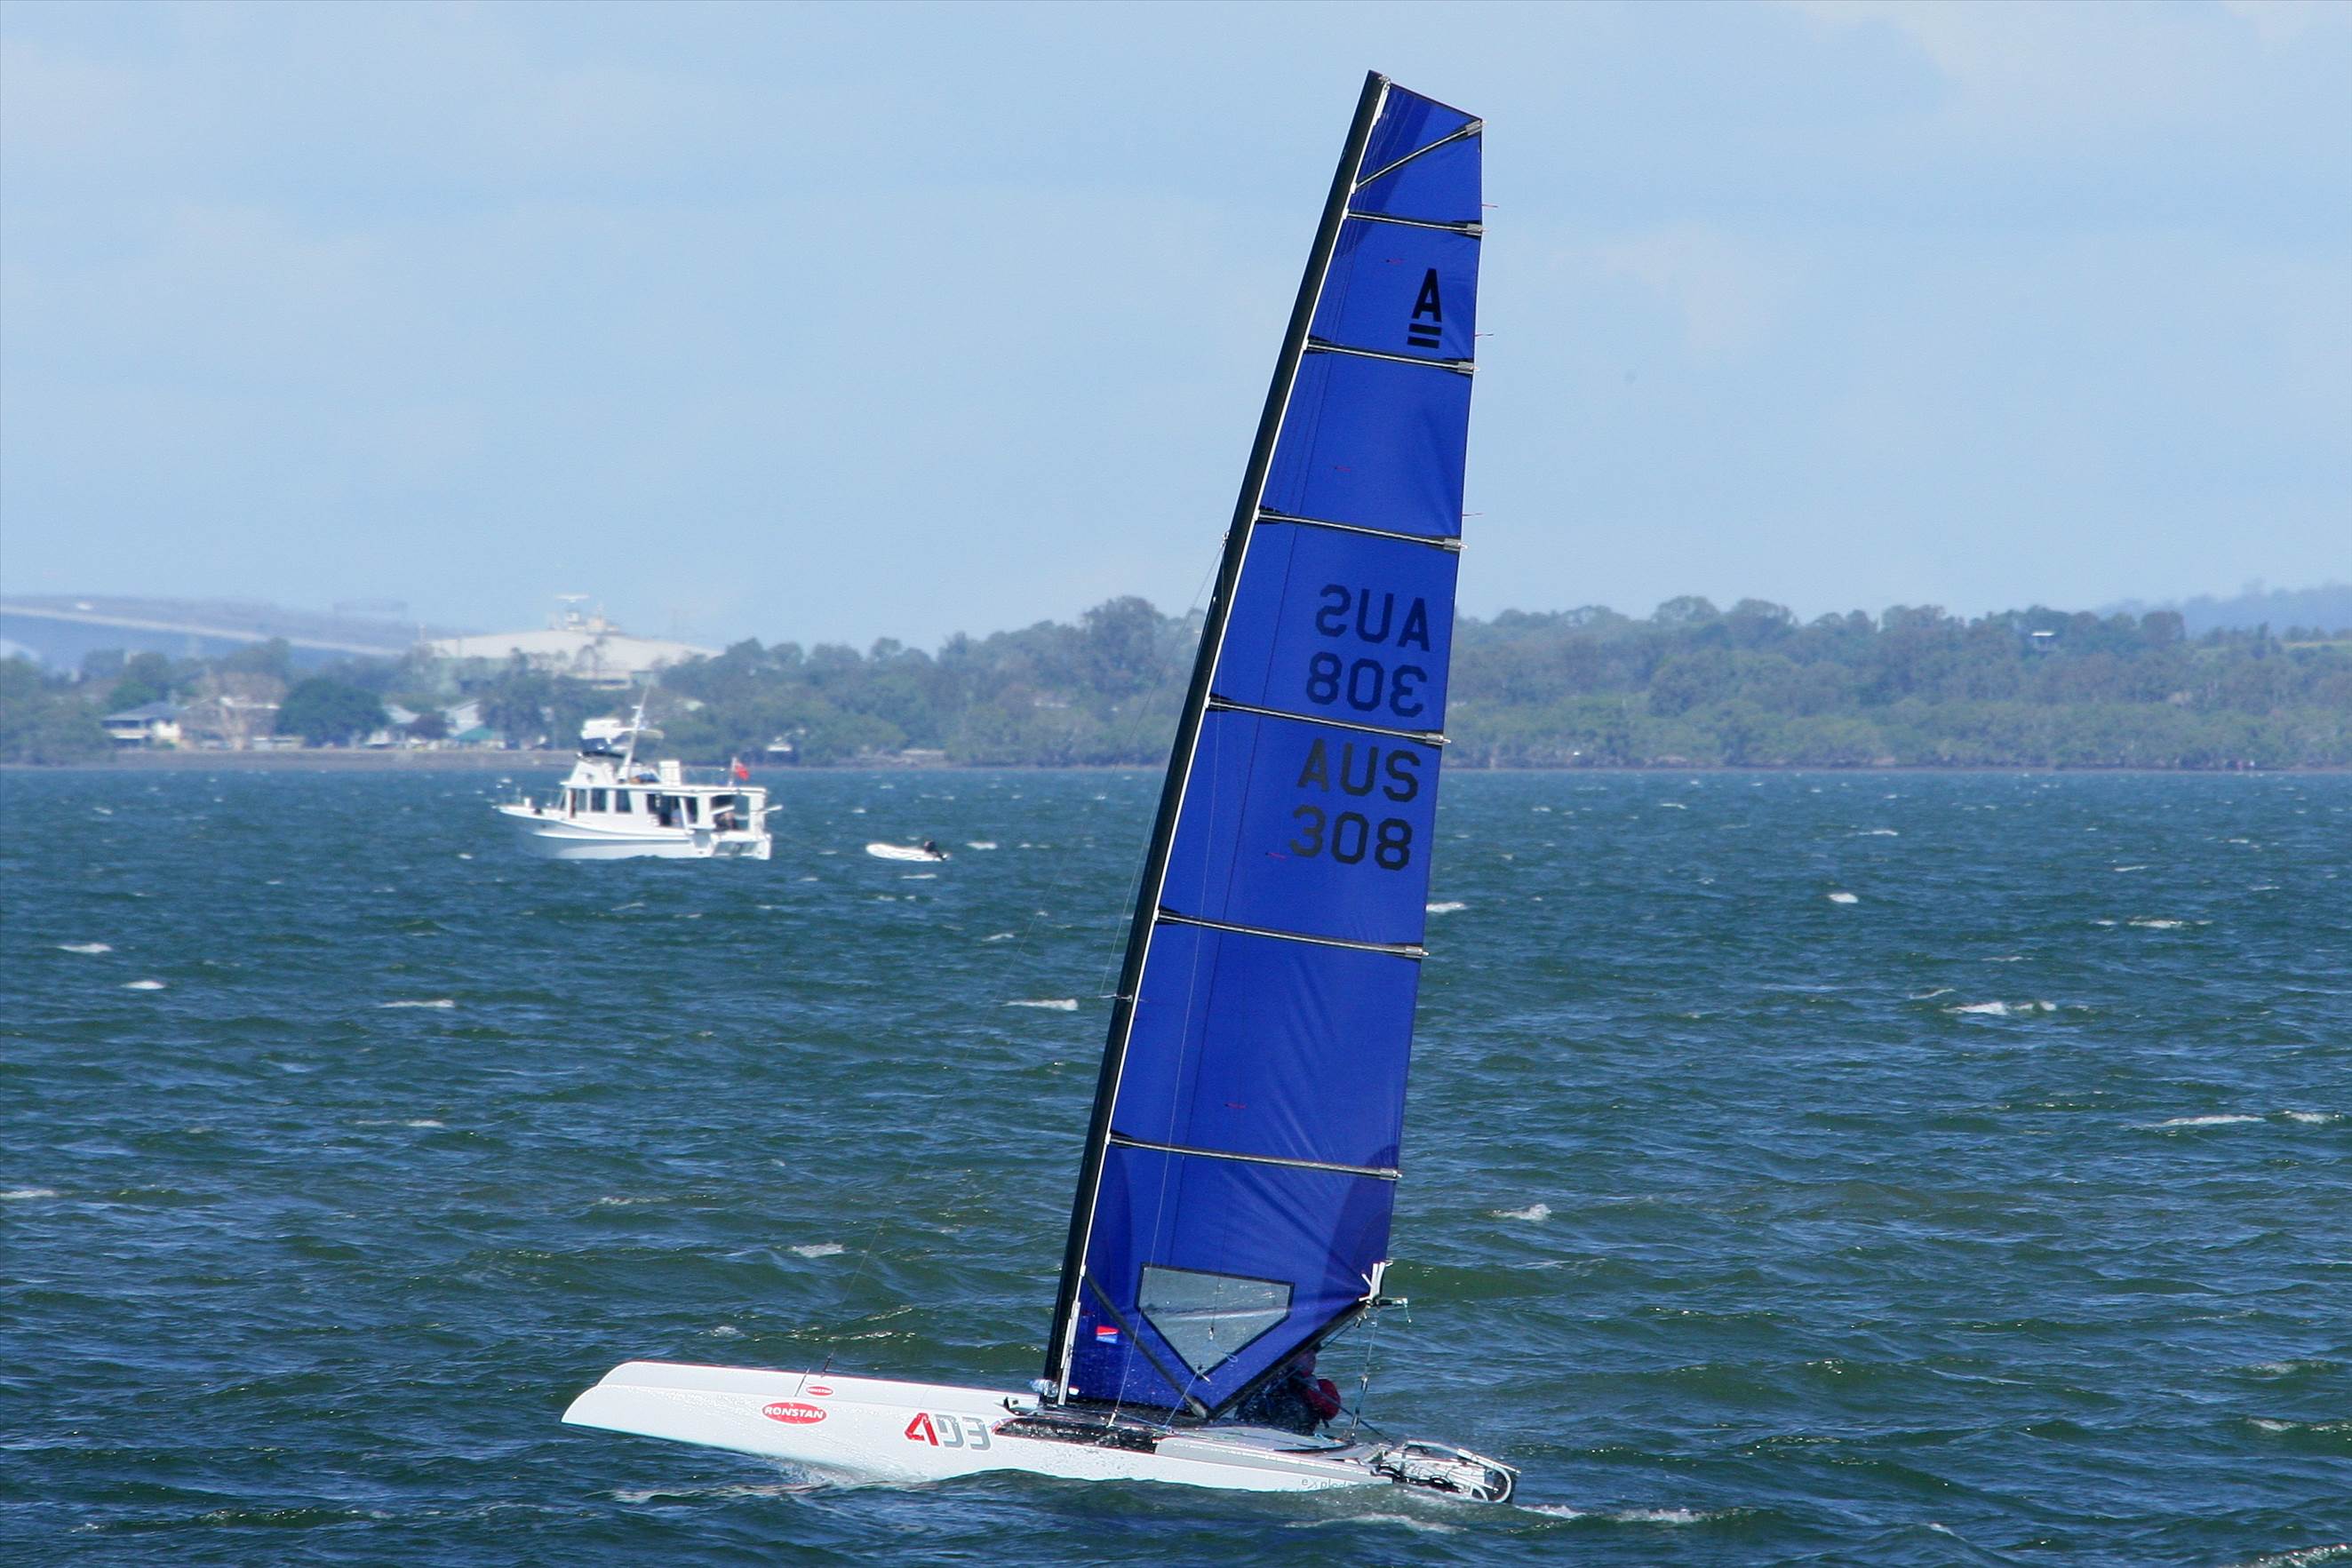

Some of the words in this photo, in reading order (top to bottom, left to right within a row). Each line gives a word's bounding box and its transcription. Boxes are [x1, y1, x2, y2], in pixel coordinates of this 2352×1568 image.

[1412, 268, 1442, 322] A
[1297, 737, 1421, 803] AUS
[1290, 805, 1413, 872] 308
[764, 1406, 825, 1419] RONSTAN
